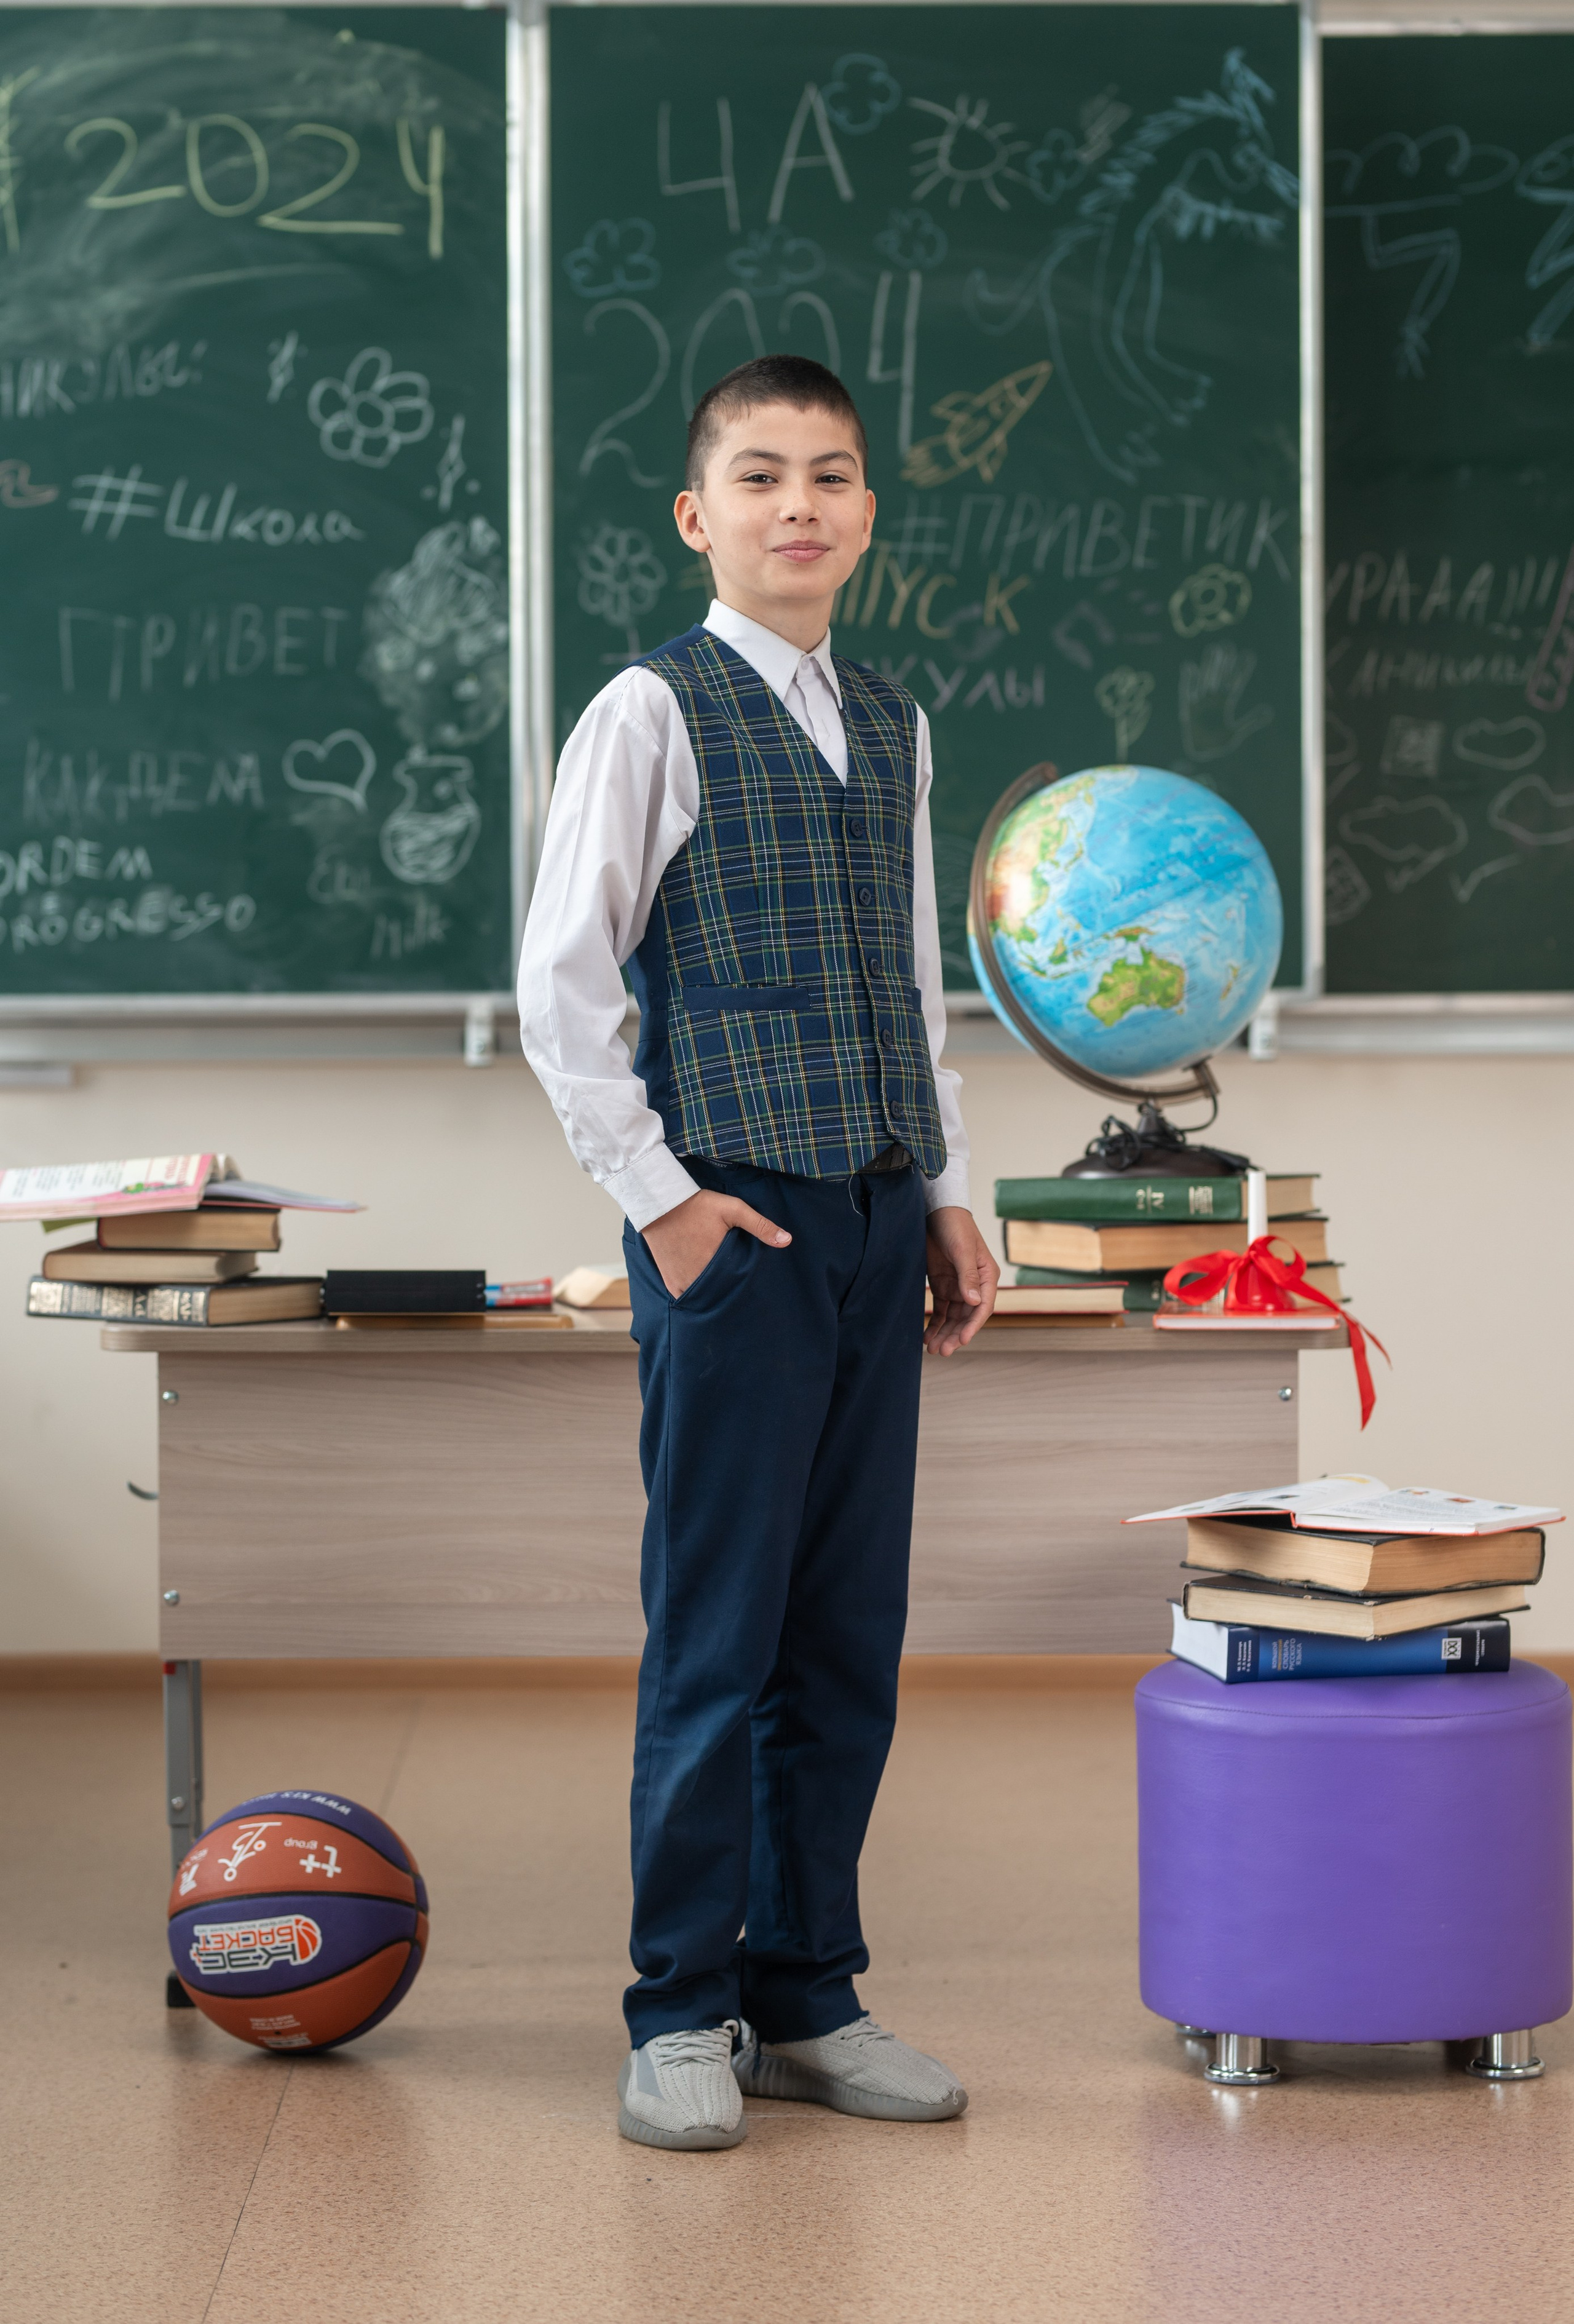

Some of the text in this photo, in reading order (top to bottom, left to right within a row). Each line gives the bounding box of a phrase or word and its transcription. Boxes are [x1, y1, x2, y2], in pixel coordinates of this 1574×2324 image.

[65, 113, 445, 260] 2024
[888, 491, 1292, 582] #ПРИВЕТИК
[57, 601, 350, 704] ПРИВЕТ
[0, 886, 257, 955] ROGRESSO
[283, 1837, 318, 1850] group
[198, 1925, 295, 1952] БАСКЕТ
